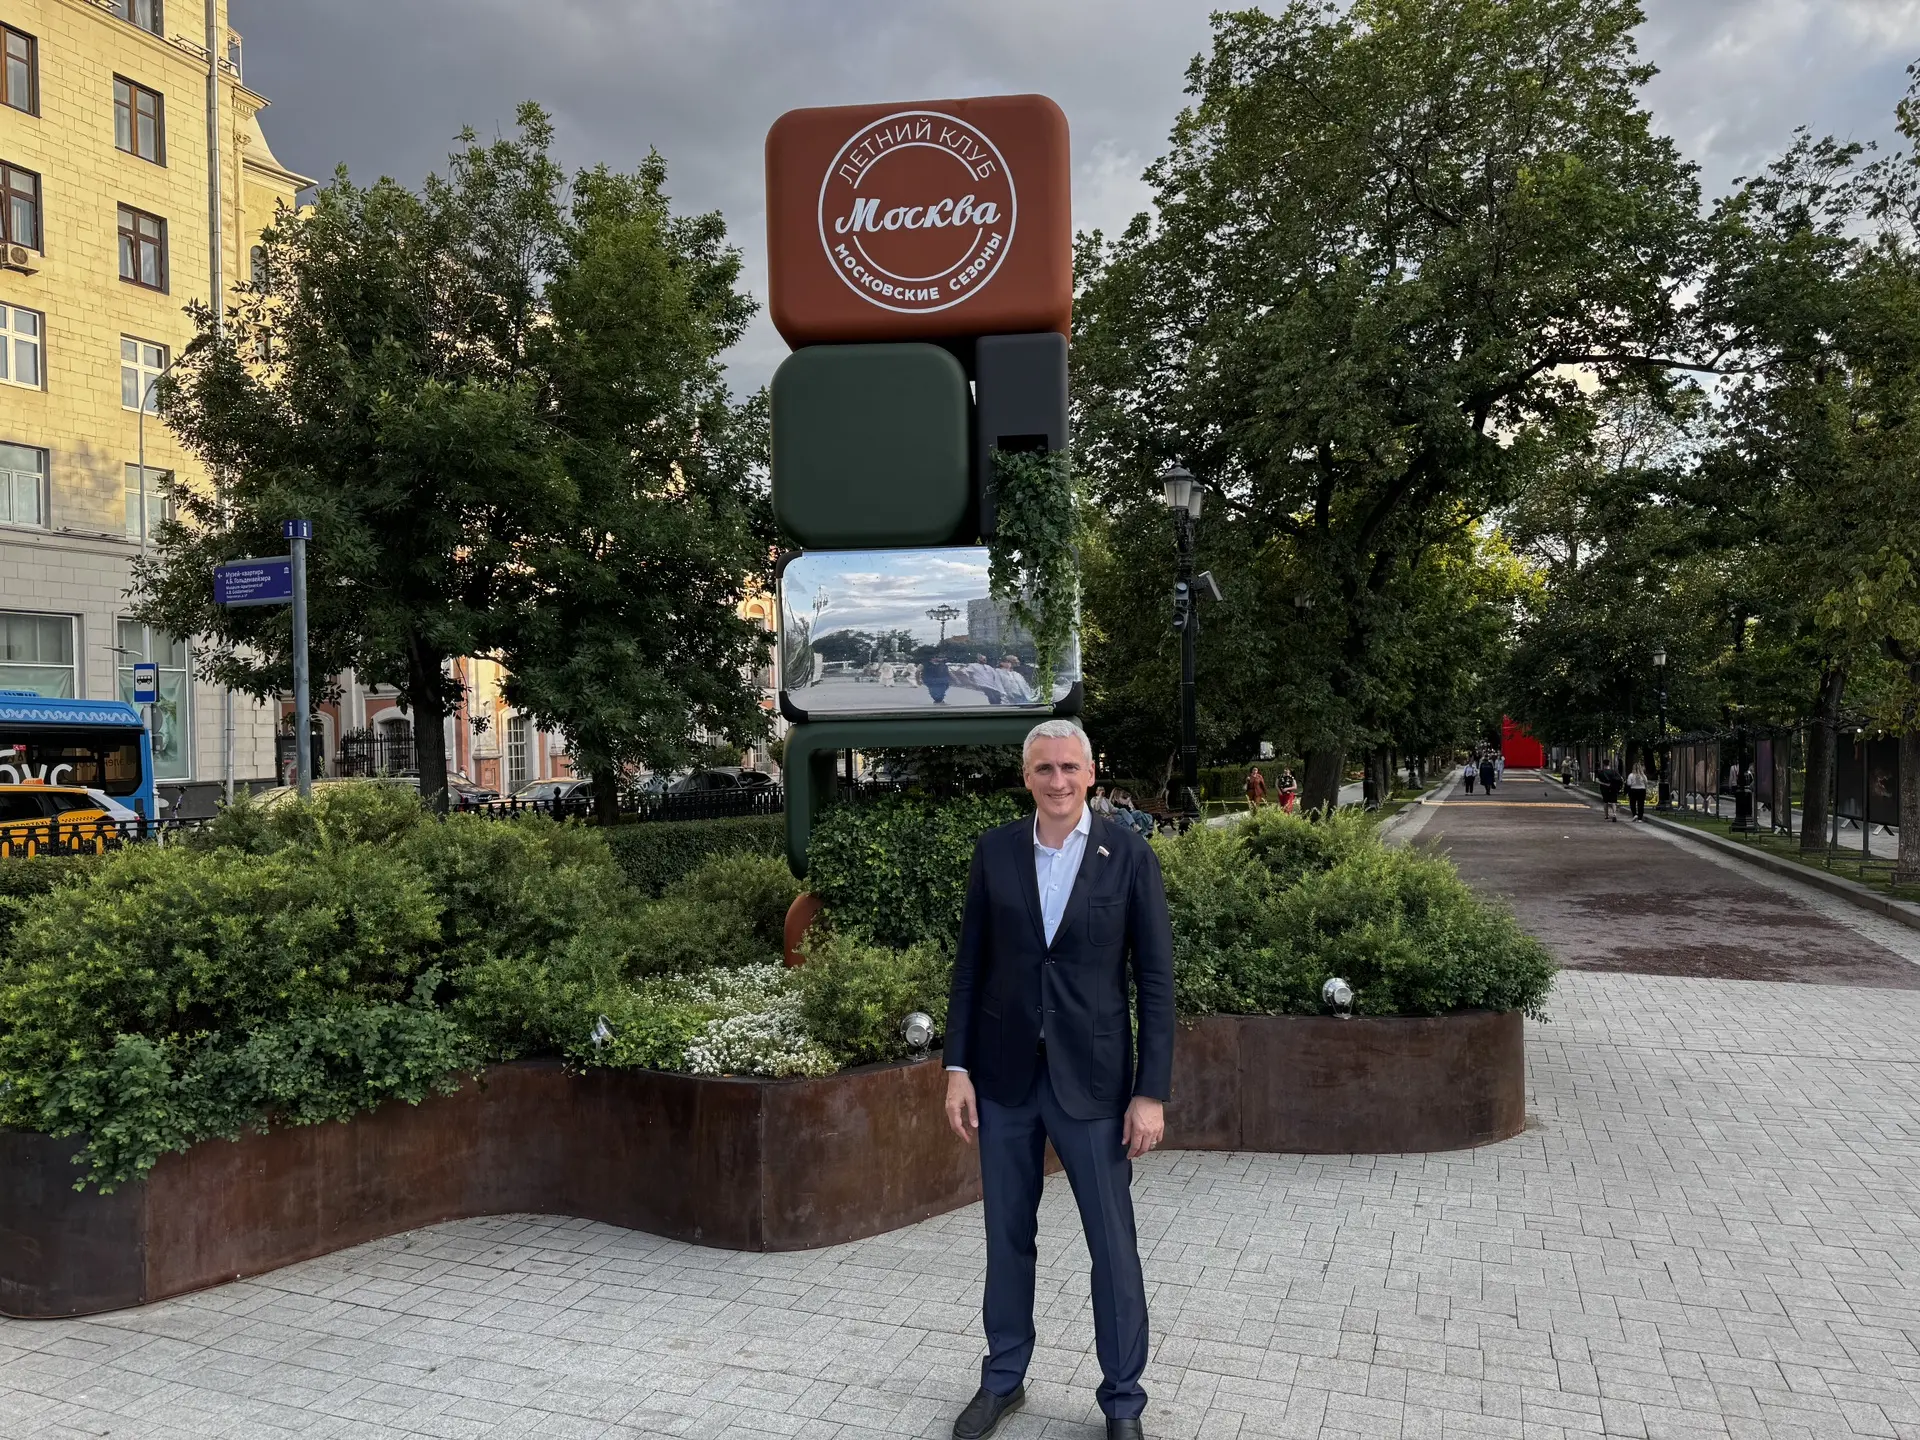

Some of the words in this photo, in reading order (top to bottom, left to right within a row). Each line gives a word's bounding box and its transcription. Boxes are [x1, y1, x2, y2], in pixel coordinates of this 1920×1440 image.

[839, 118, 931, 184] ЛЕТНИЙ
[939, 126, 997, 179] КЛУБ
[834, 194, 1001, 234] Москва
[834, 243, 940, 301] МОСКОВСКИЕ
[949, 232, 1003, 291] СЕЗОНЫ
